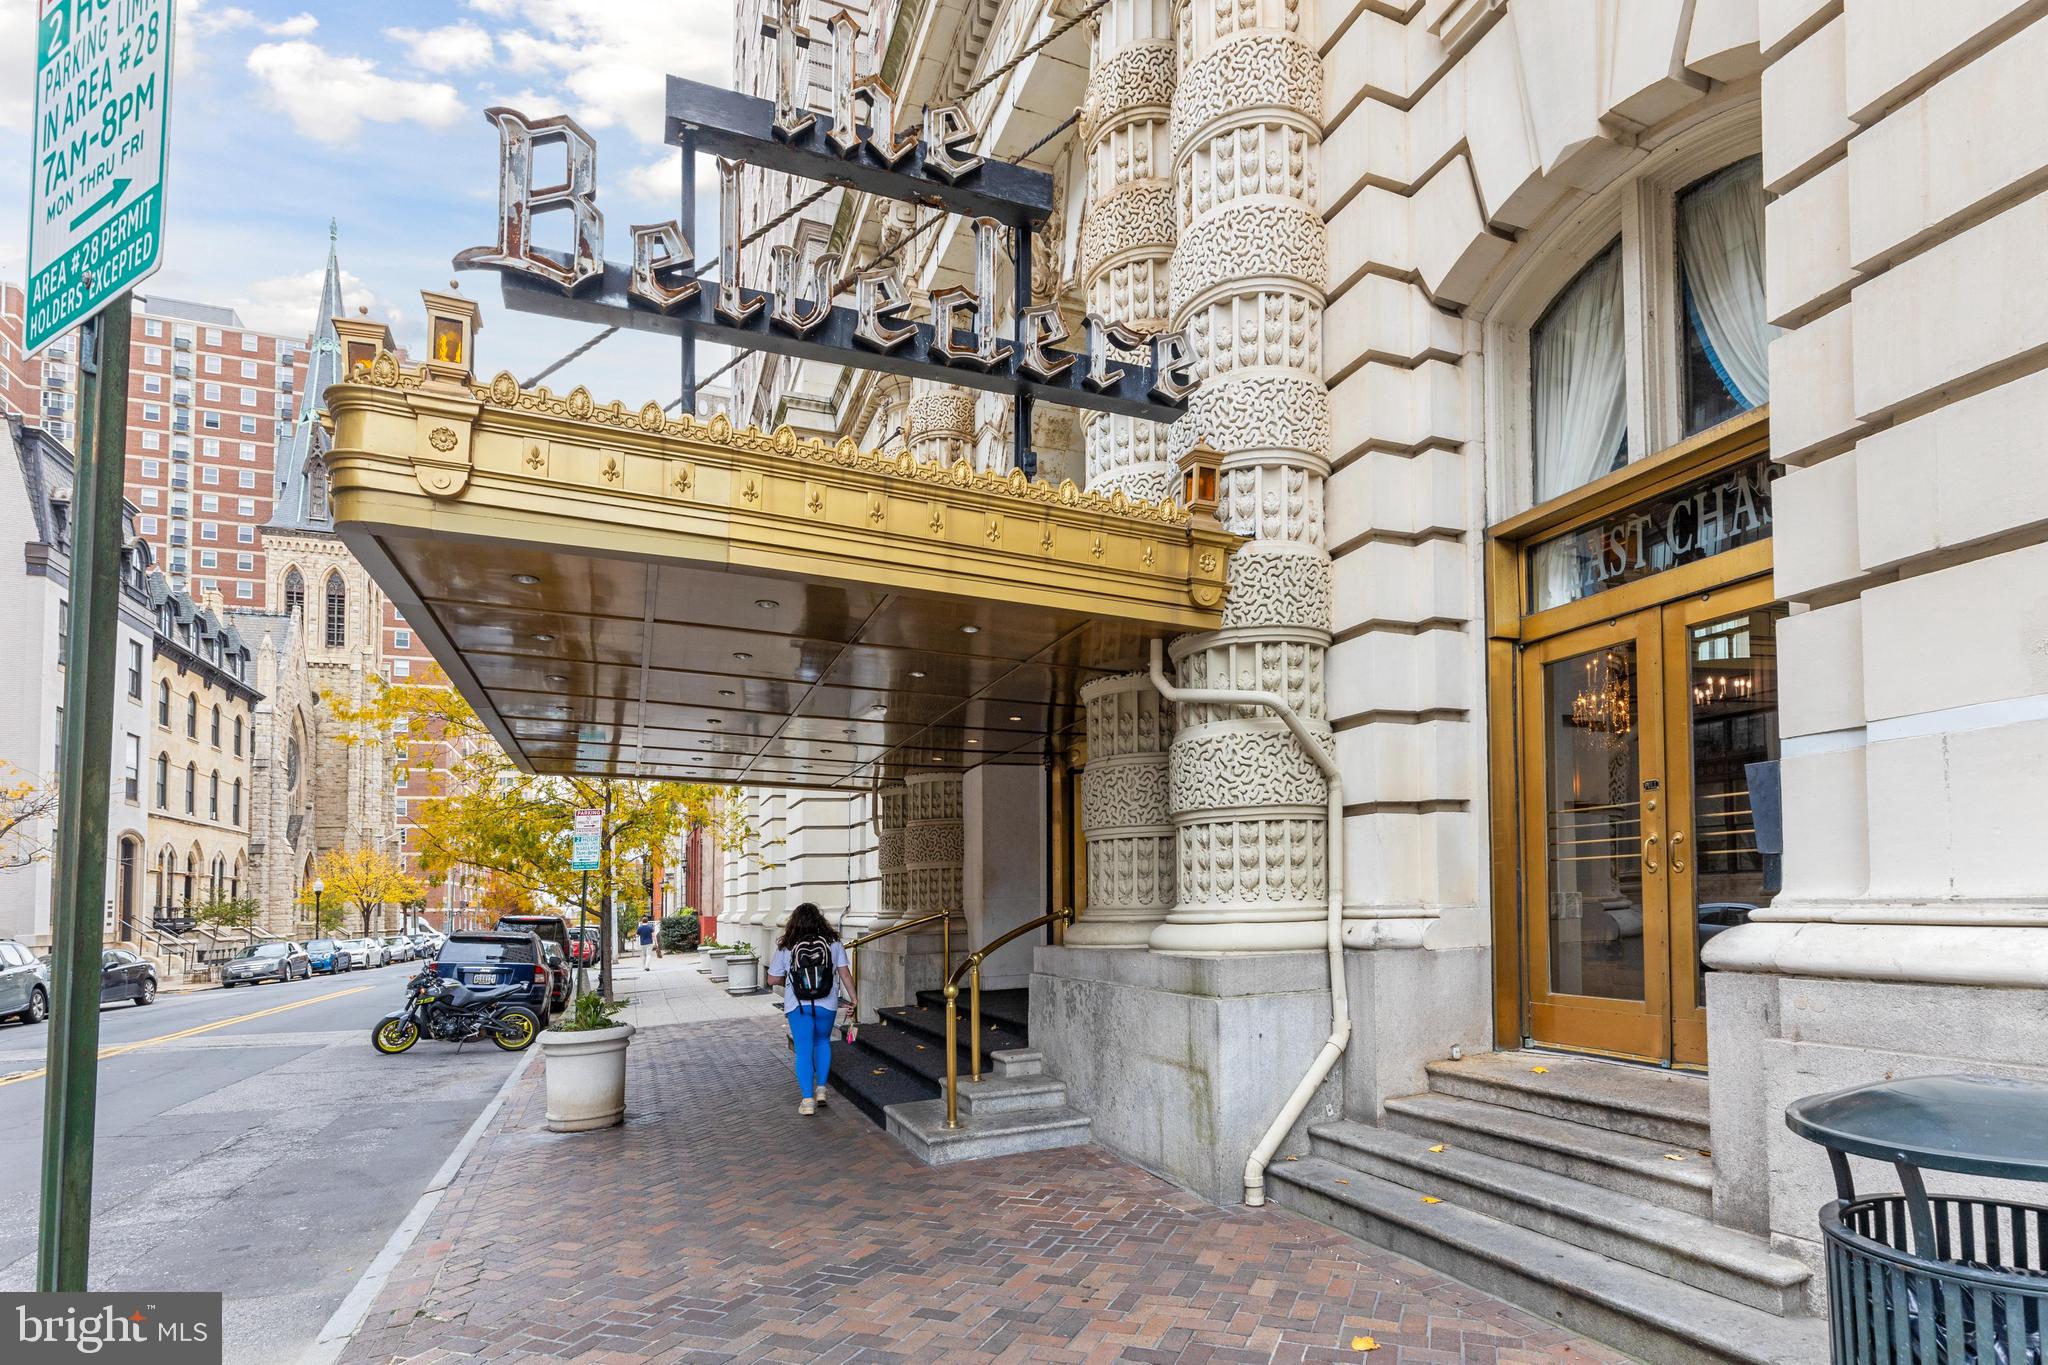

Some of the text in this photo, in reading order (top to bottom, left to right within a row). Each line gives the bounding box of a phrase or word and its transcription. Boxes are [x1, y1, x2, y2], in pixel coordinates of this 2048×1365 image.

[43, 10, 159, 152] IN AREA #28
[45, 0, 156, 105] PARKING LIM
[47, 9, 64, 58] 2
[43, 72, 154, 198] 7AM-8PM
[46, 129, 144, 225] MON THRU FRI
[30, 232, 153, 341] HOLDERS EXCEPTED
[32, 194, 154, 307] AREA #28 PERMIT
[452, 106, 1200, 403] Belvedere
